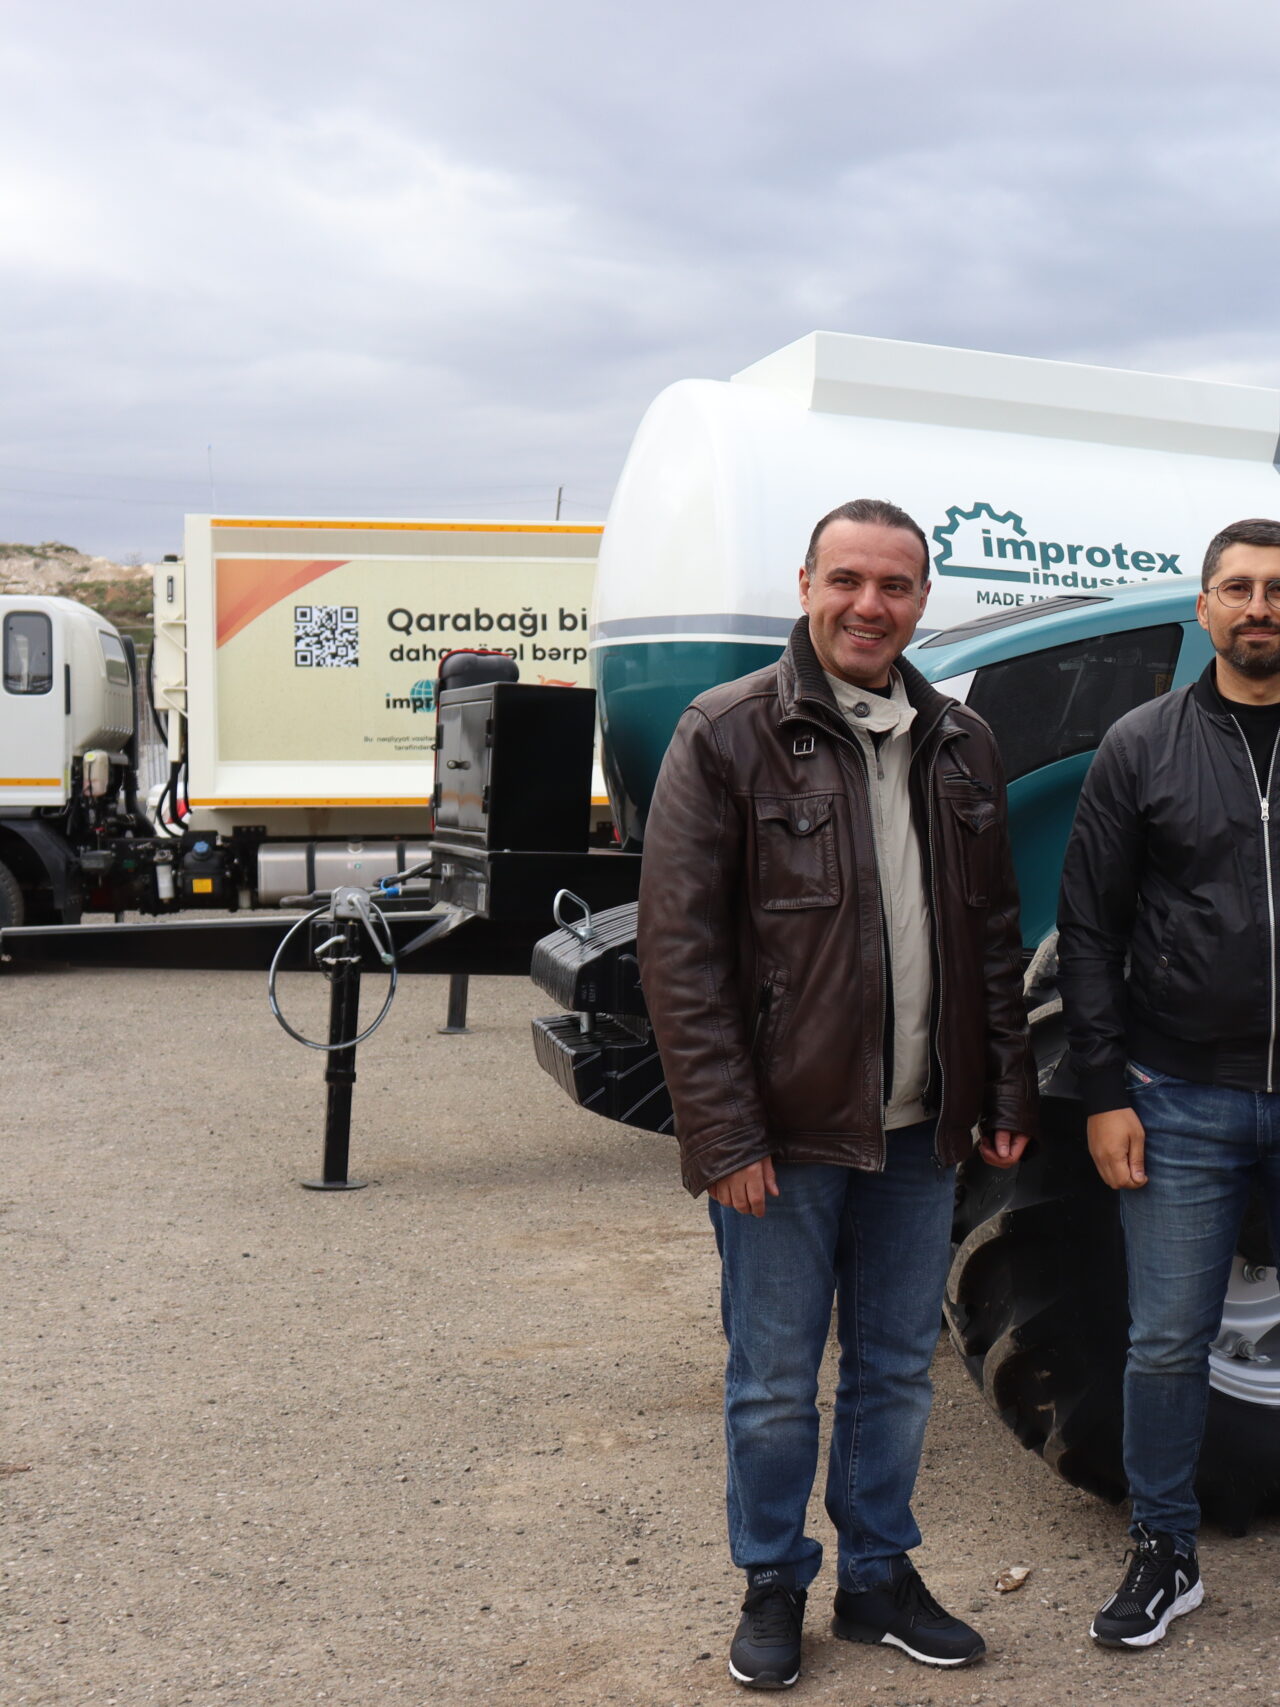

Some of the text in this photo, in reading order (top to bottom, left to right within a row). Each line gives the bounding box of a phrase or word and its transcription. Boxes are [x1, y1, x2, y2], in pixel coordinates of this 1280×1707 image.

[981, 528, 1183, 575] improtex
[1032, 568, 1148, 589] indust
[976, 590, 1025, 607] MADE
[387, 607, 588, 637] Qarabağı bi
[532, 643, 588, 664] bərp
[385, 692, 434, 713] impr
